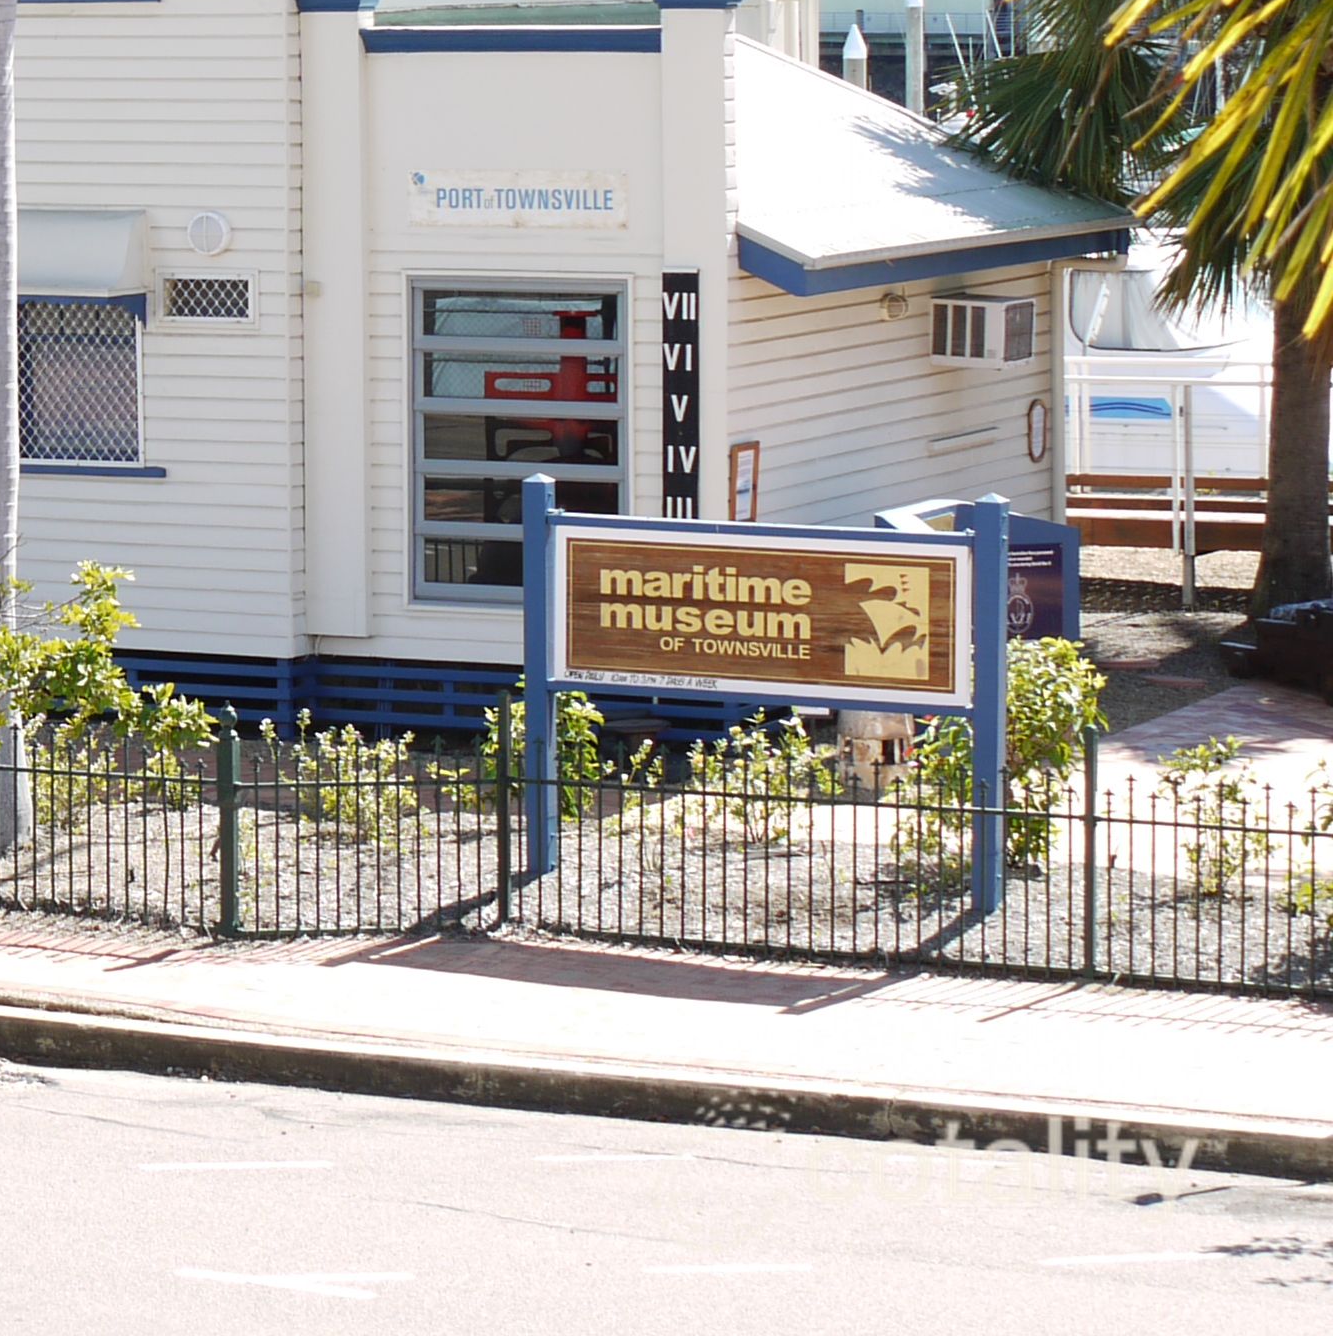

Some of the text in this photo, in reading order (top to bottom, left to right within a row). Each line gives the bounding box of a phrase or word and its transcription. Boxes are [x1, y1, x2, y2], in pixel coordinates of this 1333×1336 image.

[436, 188, 482, 209] PORT
[494, 189, 613, 210] TOWNSVILLE
[663, 292, 696, 320] VII
[663, 343, 692, 371] VI
[671, 395, 688, 422] V
[667, 445, 696, 473] IV
[666, 496, 692, 519] III
[599, 565, 812, 606] maritime
[599, 602, 812, 640] museum
[660, 636, 811, 660] OF TOWNSVILLE
